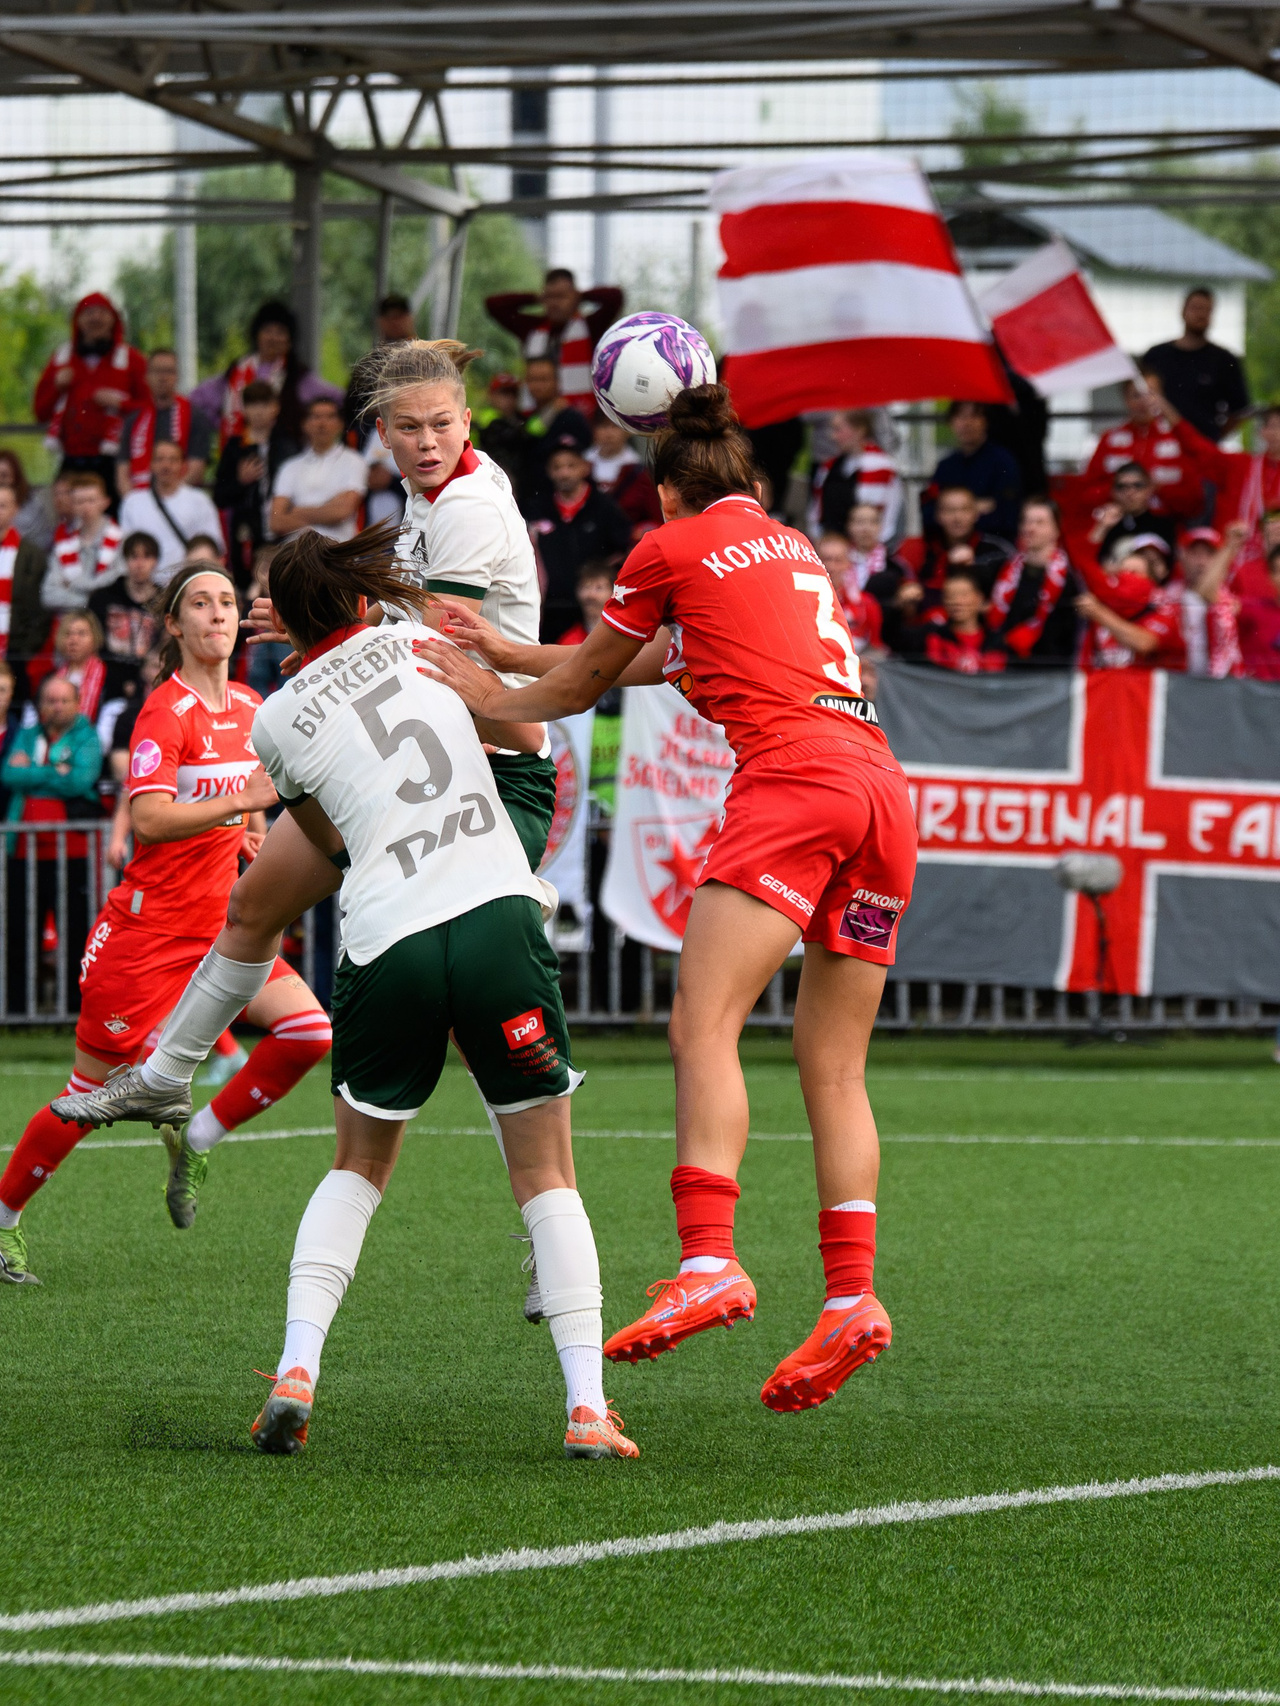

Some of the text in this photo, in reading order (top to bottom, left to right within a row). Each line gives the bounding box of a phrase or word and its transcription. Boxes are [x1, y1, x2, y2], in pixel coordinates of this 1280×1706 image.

[792, 572, 862, 696] 3
[351, 674, 453, 805] 5
[1189, 799, 1280, 858] FA
[759, 873, 816, 917] GENESIS
[852, 888, 905, 910] ЛУКОЙЛ
